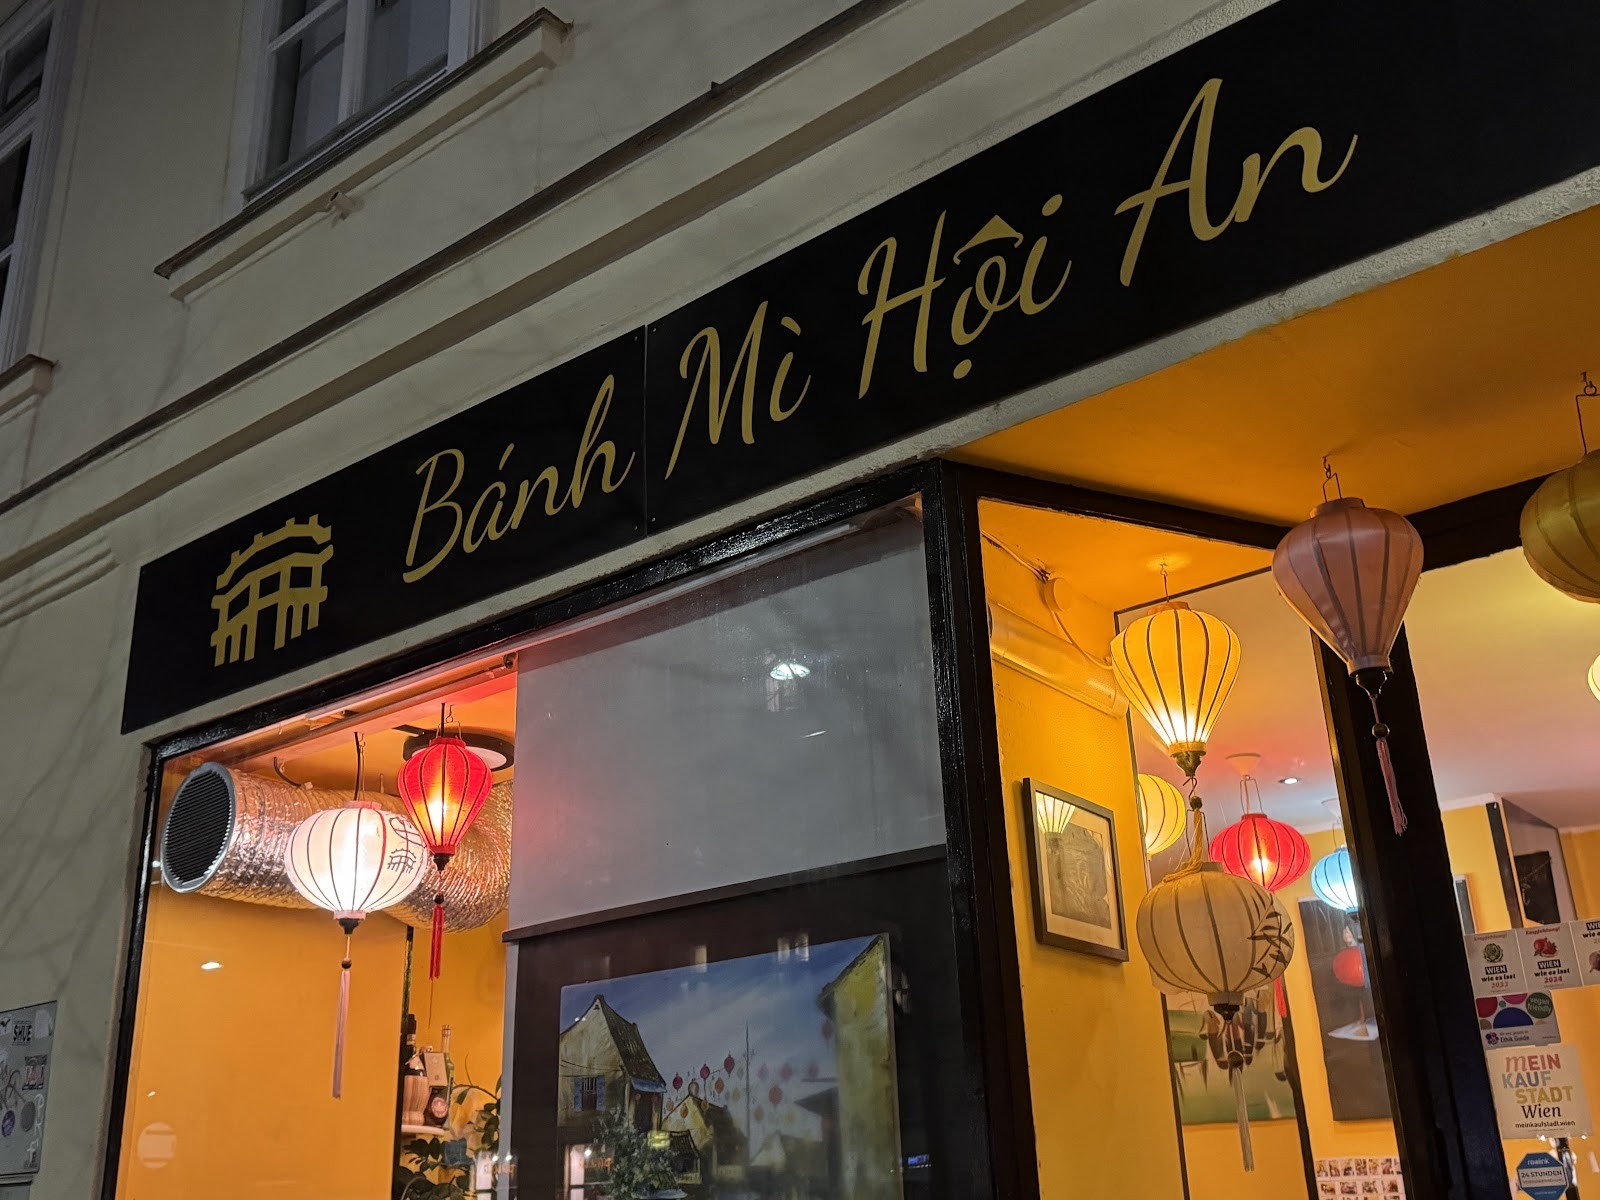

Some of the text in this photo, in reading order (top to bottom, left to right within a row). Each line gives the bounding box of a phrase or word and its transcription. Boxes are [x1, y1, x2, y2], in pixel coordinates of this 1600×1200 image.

[402, 78, 1359, 584] Bánh Mì Hội An
[1538, 960, 1561, 969] WIEN
[1485, 965, 1507, 974] WIEN
[1544, 975, 1563, 983] 2024
[1502, 1070, 1551, 1088] KAUF
[1515, 1086, 1573, 1104] STADT
[1521, 1103, 1561, 1119] Wien
[1515, 1120, 1576, 1129] meinkaufstadt.wien
[1530, 1170, 1562, 1178] STUNDEN
